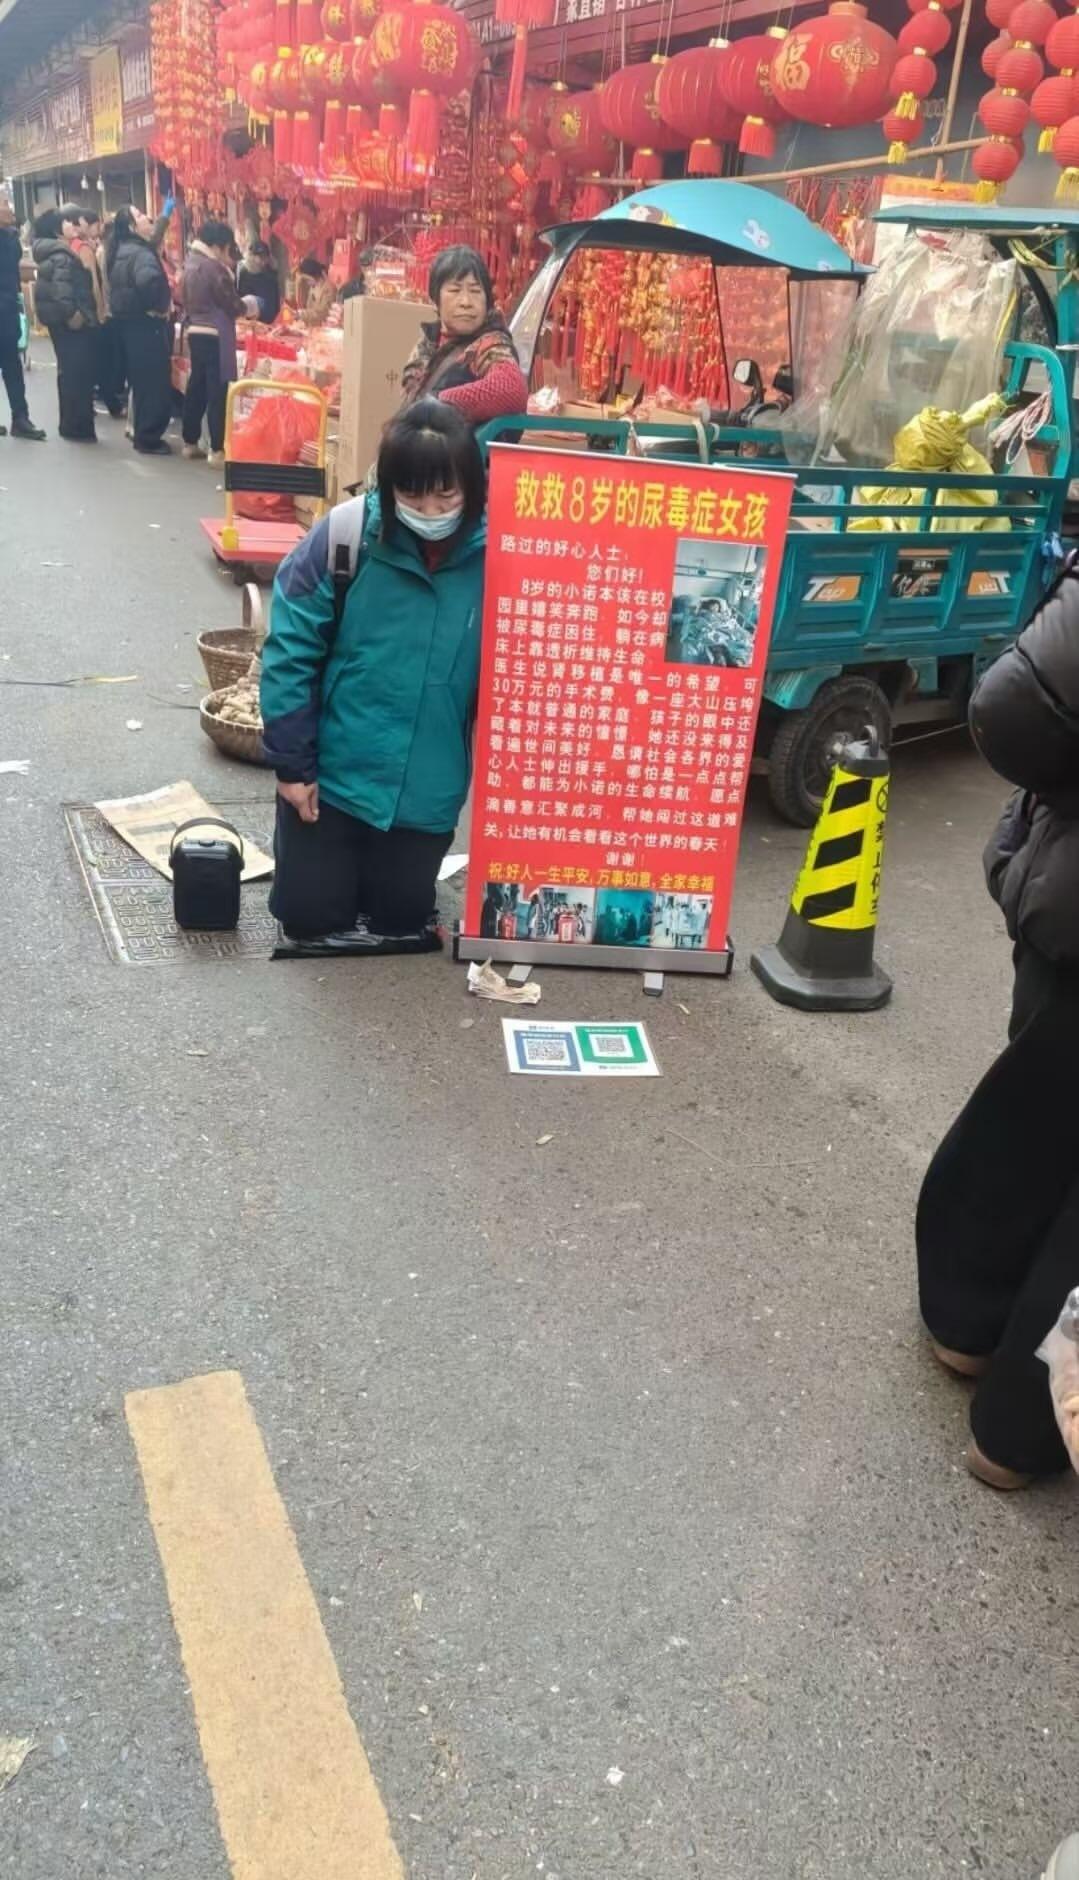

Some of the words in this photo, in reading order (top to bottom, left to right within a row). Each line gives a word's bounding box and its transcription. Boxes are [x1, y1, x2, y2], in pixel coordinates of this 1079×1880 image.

[774, 32, 811, 91] 福
[515, 469, 769, 539] 救救8岁的尿毒症女孩
[521, 578, 666, 607] 8岁的小诺本该在校
